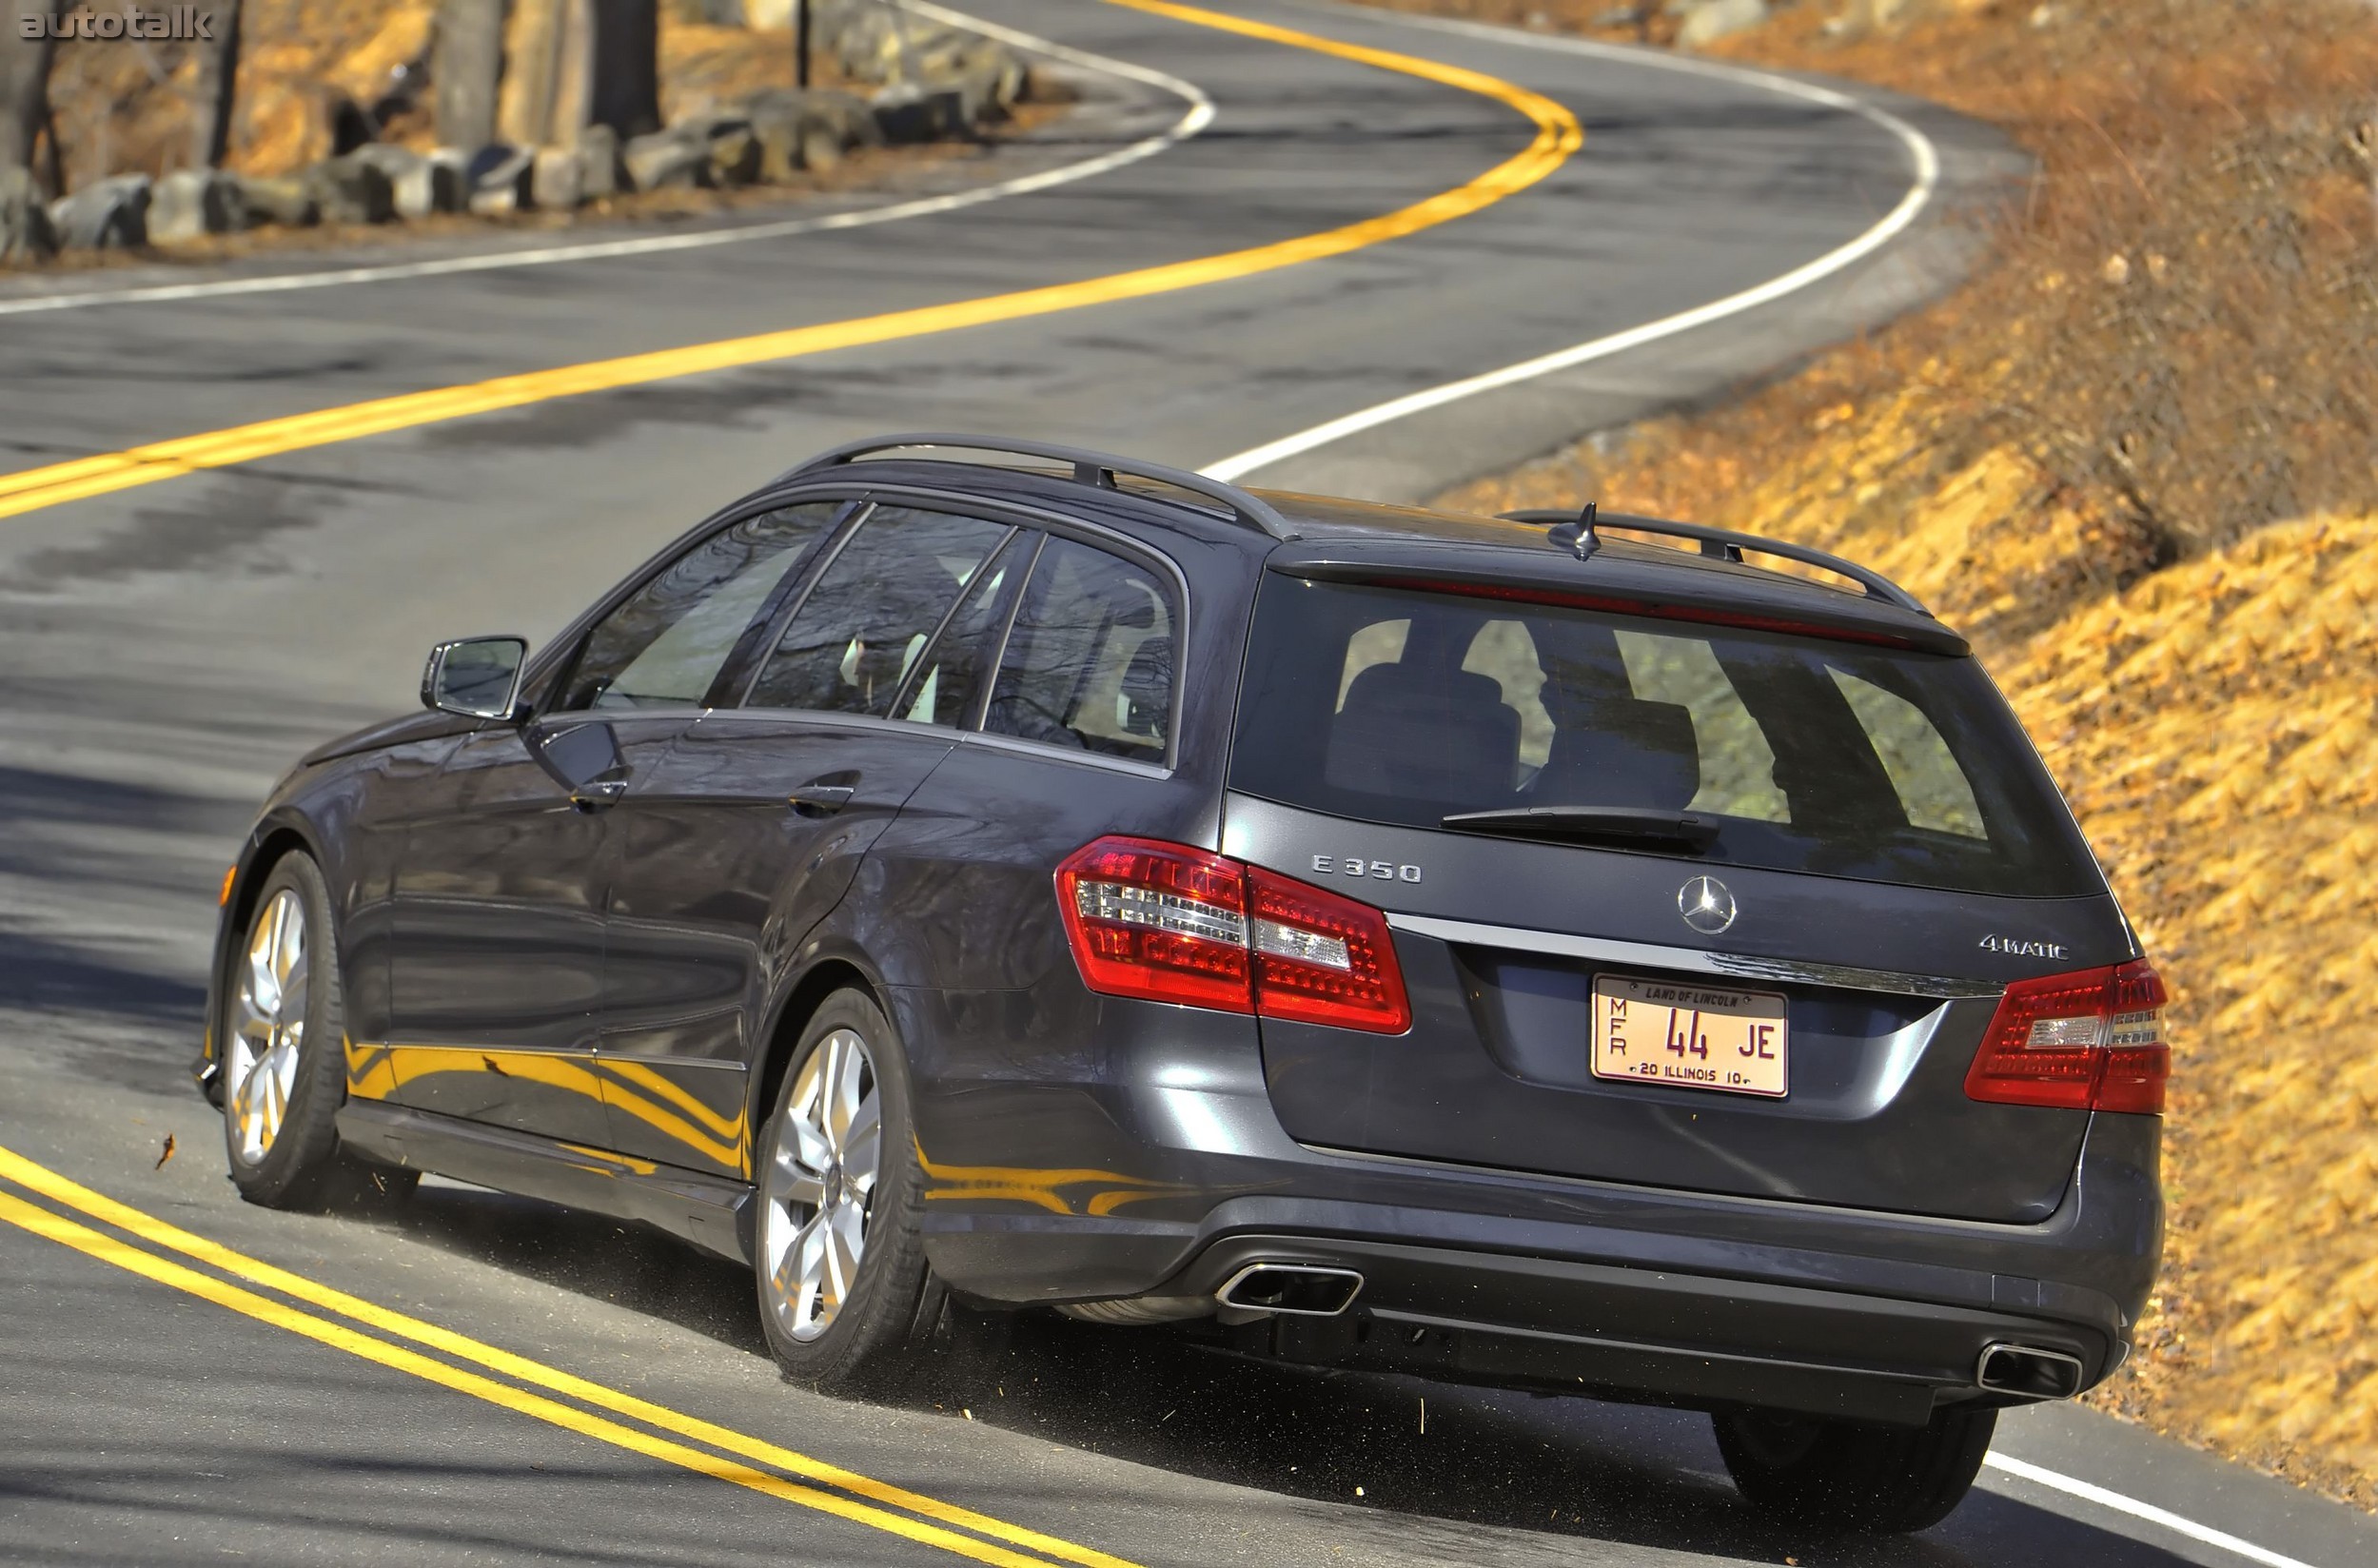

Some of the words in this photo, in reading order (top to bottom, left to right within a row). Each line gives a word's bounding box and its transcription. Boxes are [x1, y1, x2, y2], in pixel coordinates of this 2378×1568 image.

[1313, 854, 1333, 873] E
[1345, 858, 1422, 883] 350
[1979, 933, 2069, 960] 4MATIC
[1645, 988, 1675, 1000] LAND
[1678, 990, 1692, 1002] OF
[1694, 993, 1739, 1007] LINCOLN
[1667, 1008, 1708, 1059] 44
[1739, 1025, 1775, 1059] JE
[1640, 1062, 1658, 1075] 20
[1665, 1066, 1717, 1082] ILLINOIS
[1726, 1071, 1741, 1084] 10
